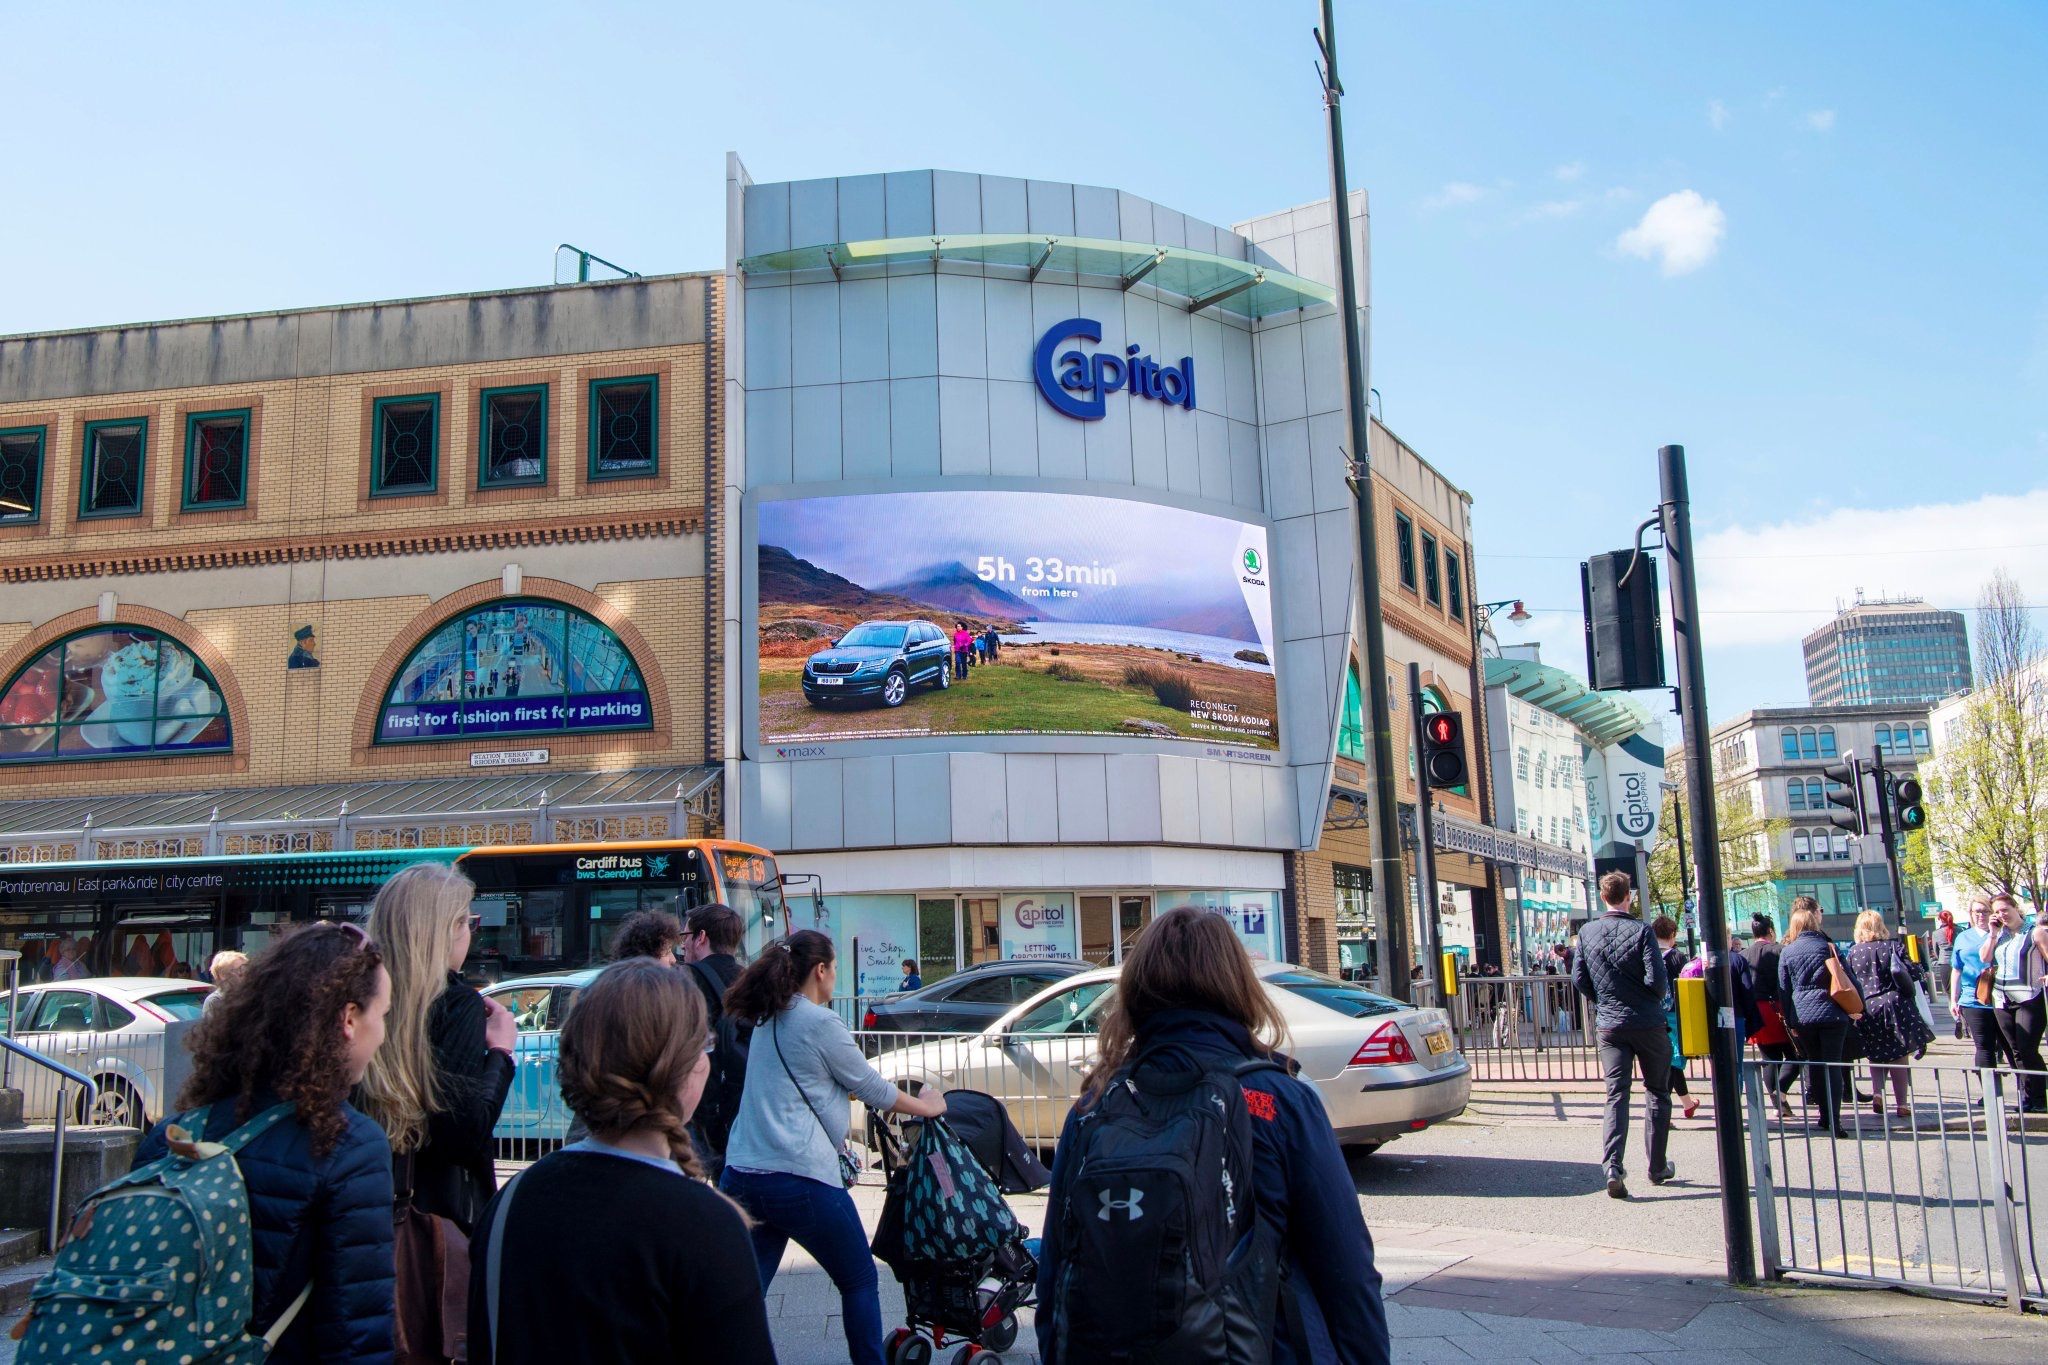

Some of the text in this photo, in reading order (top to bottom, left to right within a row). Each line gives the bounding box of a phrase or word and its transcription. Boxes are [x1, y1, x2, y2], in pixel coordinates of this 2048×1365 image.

[1034, 318, 1196, 421] Capitol
[977, 556, 1117, 586] 5h 33min
[1022, 586, 1078, 598] from here
[1190, 700, 1238, 712] RECONNECT
[388, 714, 420, 728] first
[425, 712, 448, 726] for
[514, 707, 547, 721] first
[580, 702, 642, 720] parking
[1190, 710, 1209, 719] NEW
[1241, 715, 1270, 727] KODIAQ
[504, 751, 534, 759] TERRACE
[788, 746, 826, 758] maxx
[1639, 771, 1650, 812] SHOPPING
[1616, 772, 1655, 838] Capitol
[576, 856, 642, 869] Cardiff bus
[576, 868, 643, 880] bws Caerdydd
[681, 872, 697, 881] 119
[0, 880, 70, 895] Pontprennau
[78, 877, 100, 892] East
[166, 874, 184, 890] city
[187, 874, 223, 888] centre
[1015, 899, 1064, 929] Capitol
[880, 942, 906, 958] Shop,
[1024, 944, 1057, 952] LETTING
[866, 955, 896, 967] Smile
